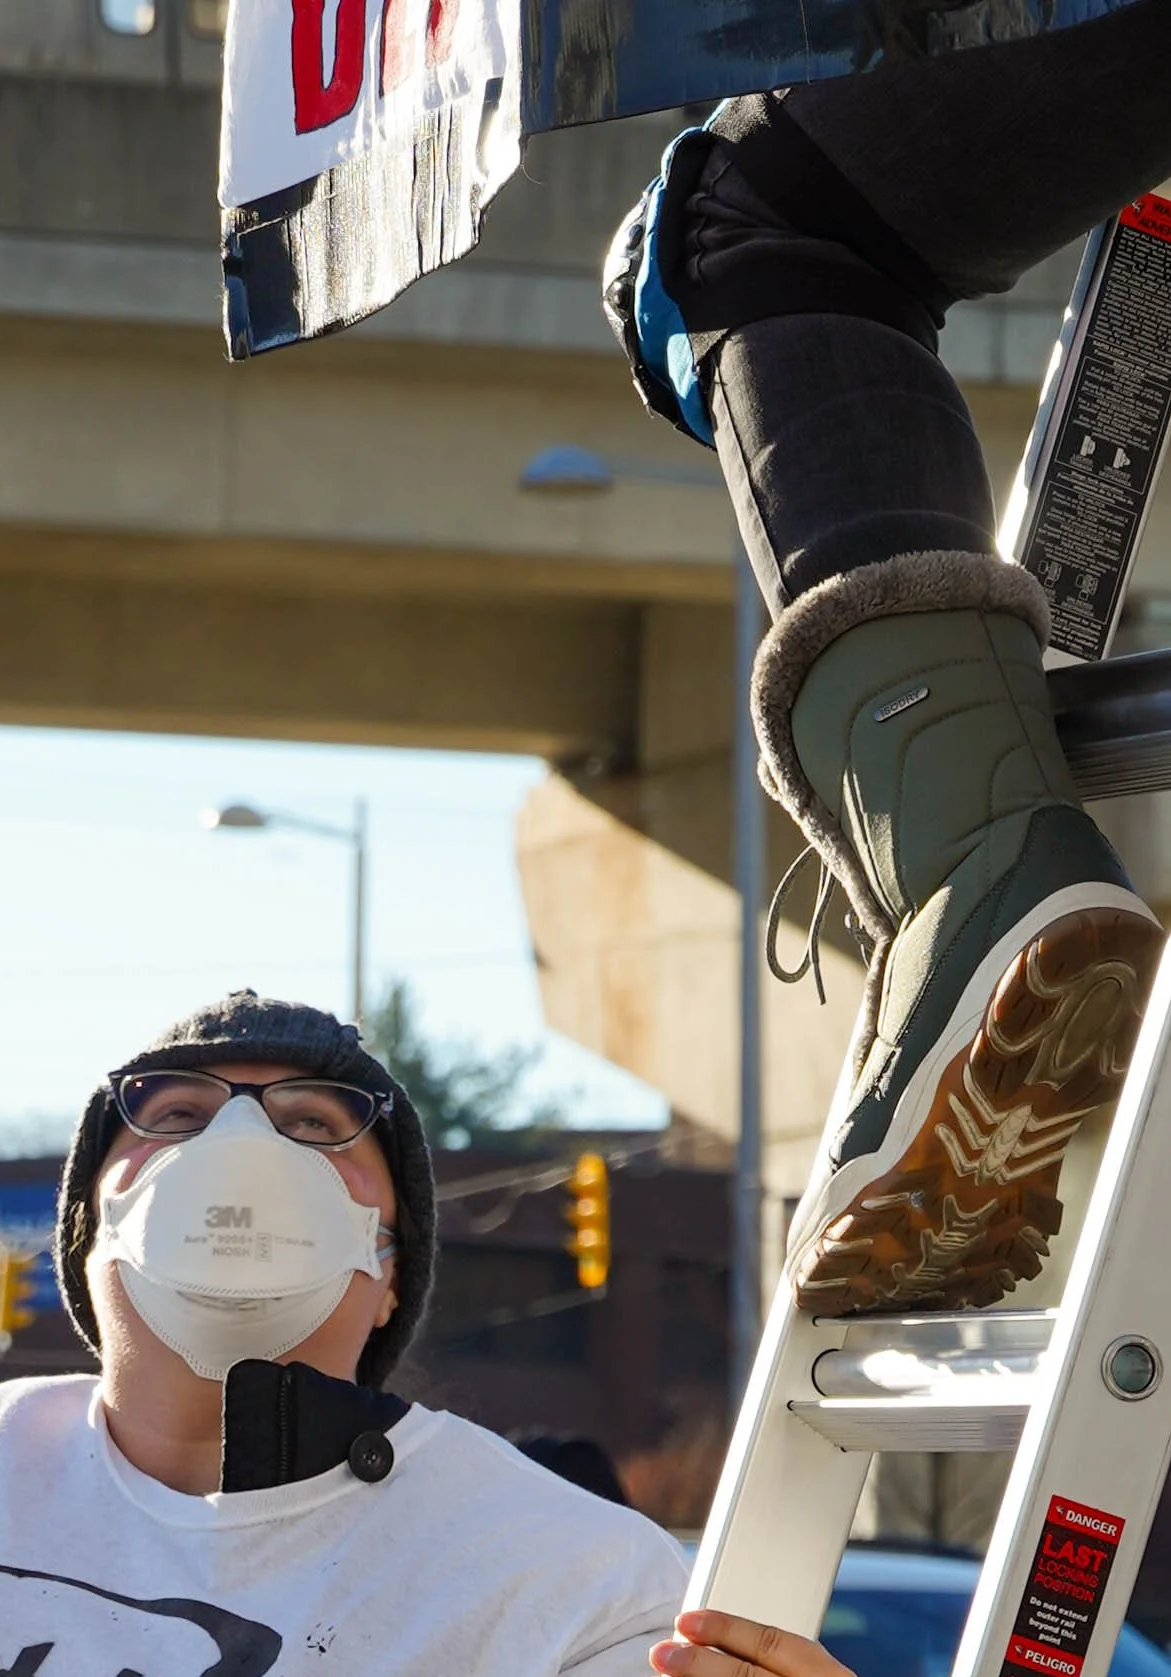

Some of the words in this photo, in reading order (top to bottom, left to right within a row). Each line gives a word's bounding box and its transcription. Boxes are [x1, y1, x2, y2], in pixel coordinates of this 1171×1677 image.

[881, 689, 920, 717] ISODRY
[205, 1206, 253, 1228] 3M
[212, 1247, 250, 1257] NIOSH
[1064, 1509, 1118, 1536] DANGER
[1040, 1534, 1107, 1573] LAST
[1037, 1557, 1100, 1588] LOCKING
[1032, 1572, 1096, 1603] POSITION
[1029, 1596, 1042, 1606] Do
[1042, 1600, 1057, 1612] not
[1058, 1606, 1088, 1622] extend
[1035, 1609, 1059, 1623] outer
[1060, 1617, 1075, 1629] rail
[1027, 1617, 1059, 1635] beyond
[1059, 1628, 1077, 1640] this
[1038, 1631, 1061, 1646] point
[1024, 1649, 1076, 1675] PELIGRO
